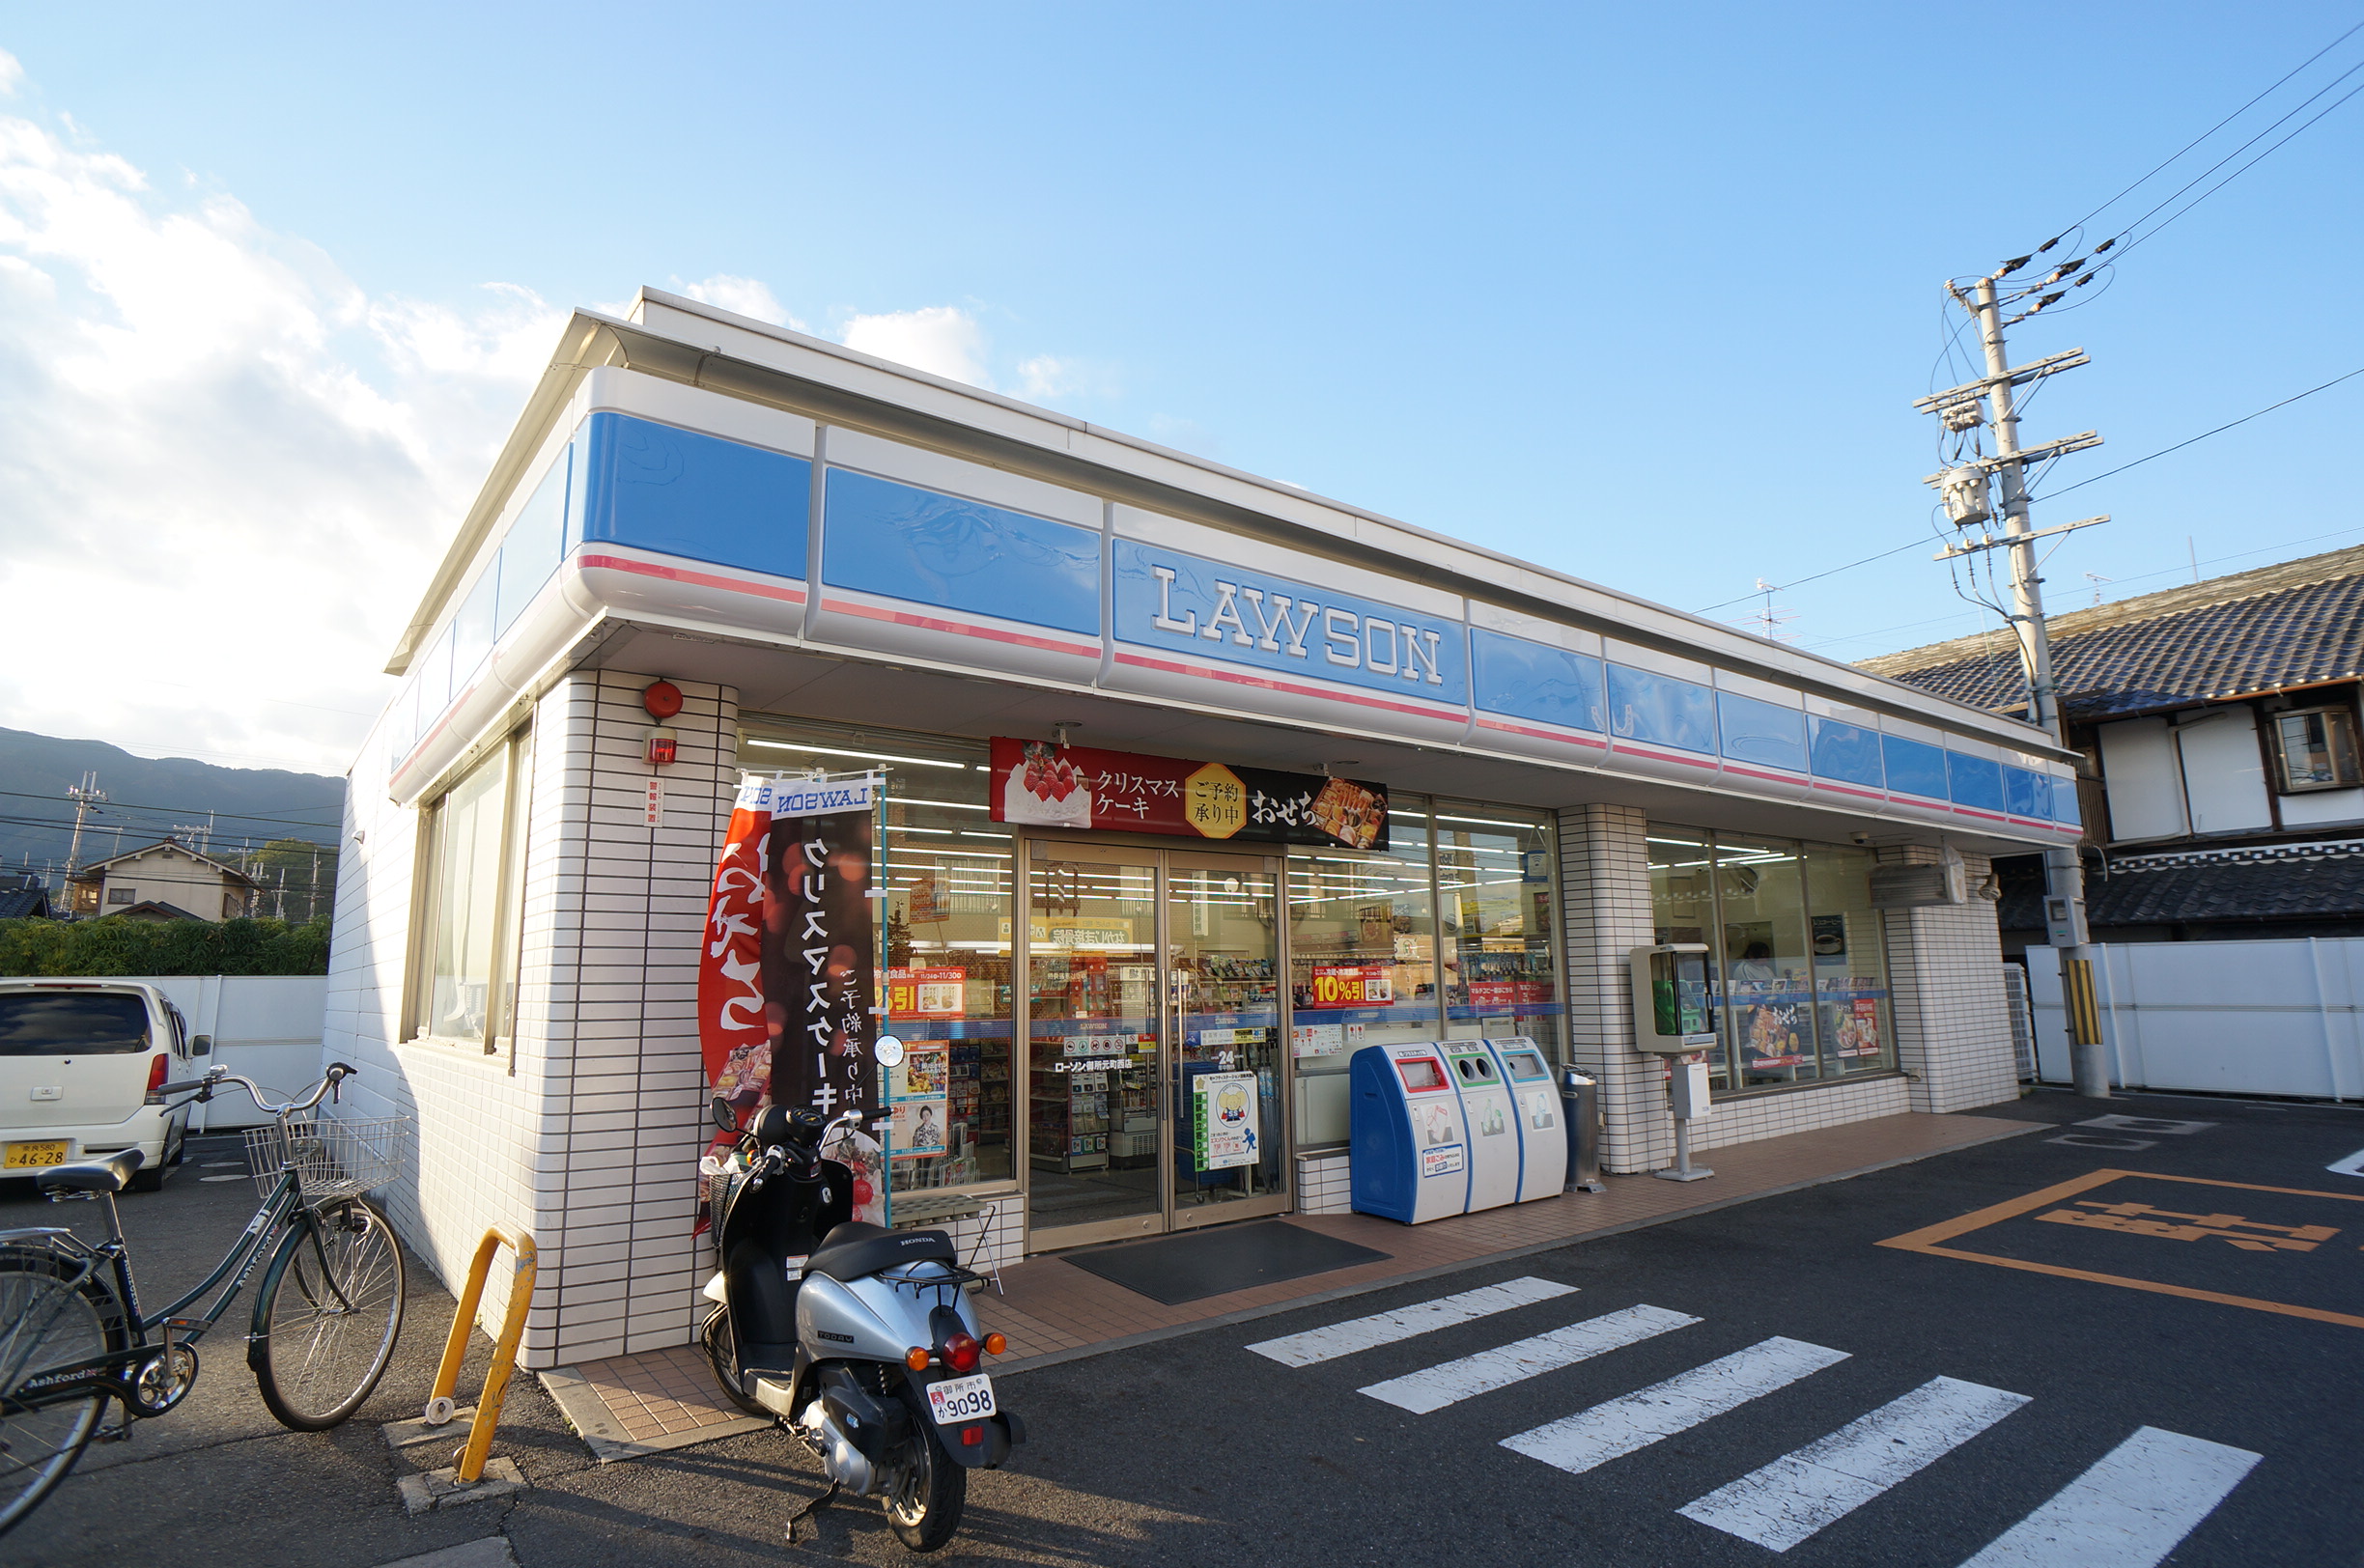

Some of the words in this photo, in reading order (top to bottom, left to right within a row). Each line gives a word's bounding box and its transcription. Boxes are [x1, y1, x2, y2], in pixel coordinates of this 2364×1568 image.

[1152, 564, 1443, 686] LAWSON
[1097, 770, 1179, 799] クリスマス
[1196, 780, 1239, 802] ご予約
[1097, 794, 1150, 820] ケーキ
[1194, 802, 1239, 826] 承り中
[1252, 790, 1317, 826] おせち
[874, 969, 906, 979] 冷食品
[1314, 975, 1365, 1002] 10%引
[1772, 1005, 1797, 1025] おせち
[1219, 1050, 1234, 1064] 24
[19, 1152, 63, 1165] 46-28
[900, 1237, 936, 1246] HONDA
[236, 1235, 273, 1290] Ashford
[819, 1332, 853, 1342] TODAY
[28, 1369, 86, 1388] Ashford
[943, 1381, 976, 1394] 御所市
[946, 1389, 992, 1416] 9098
